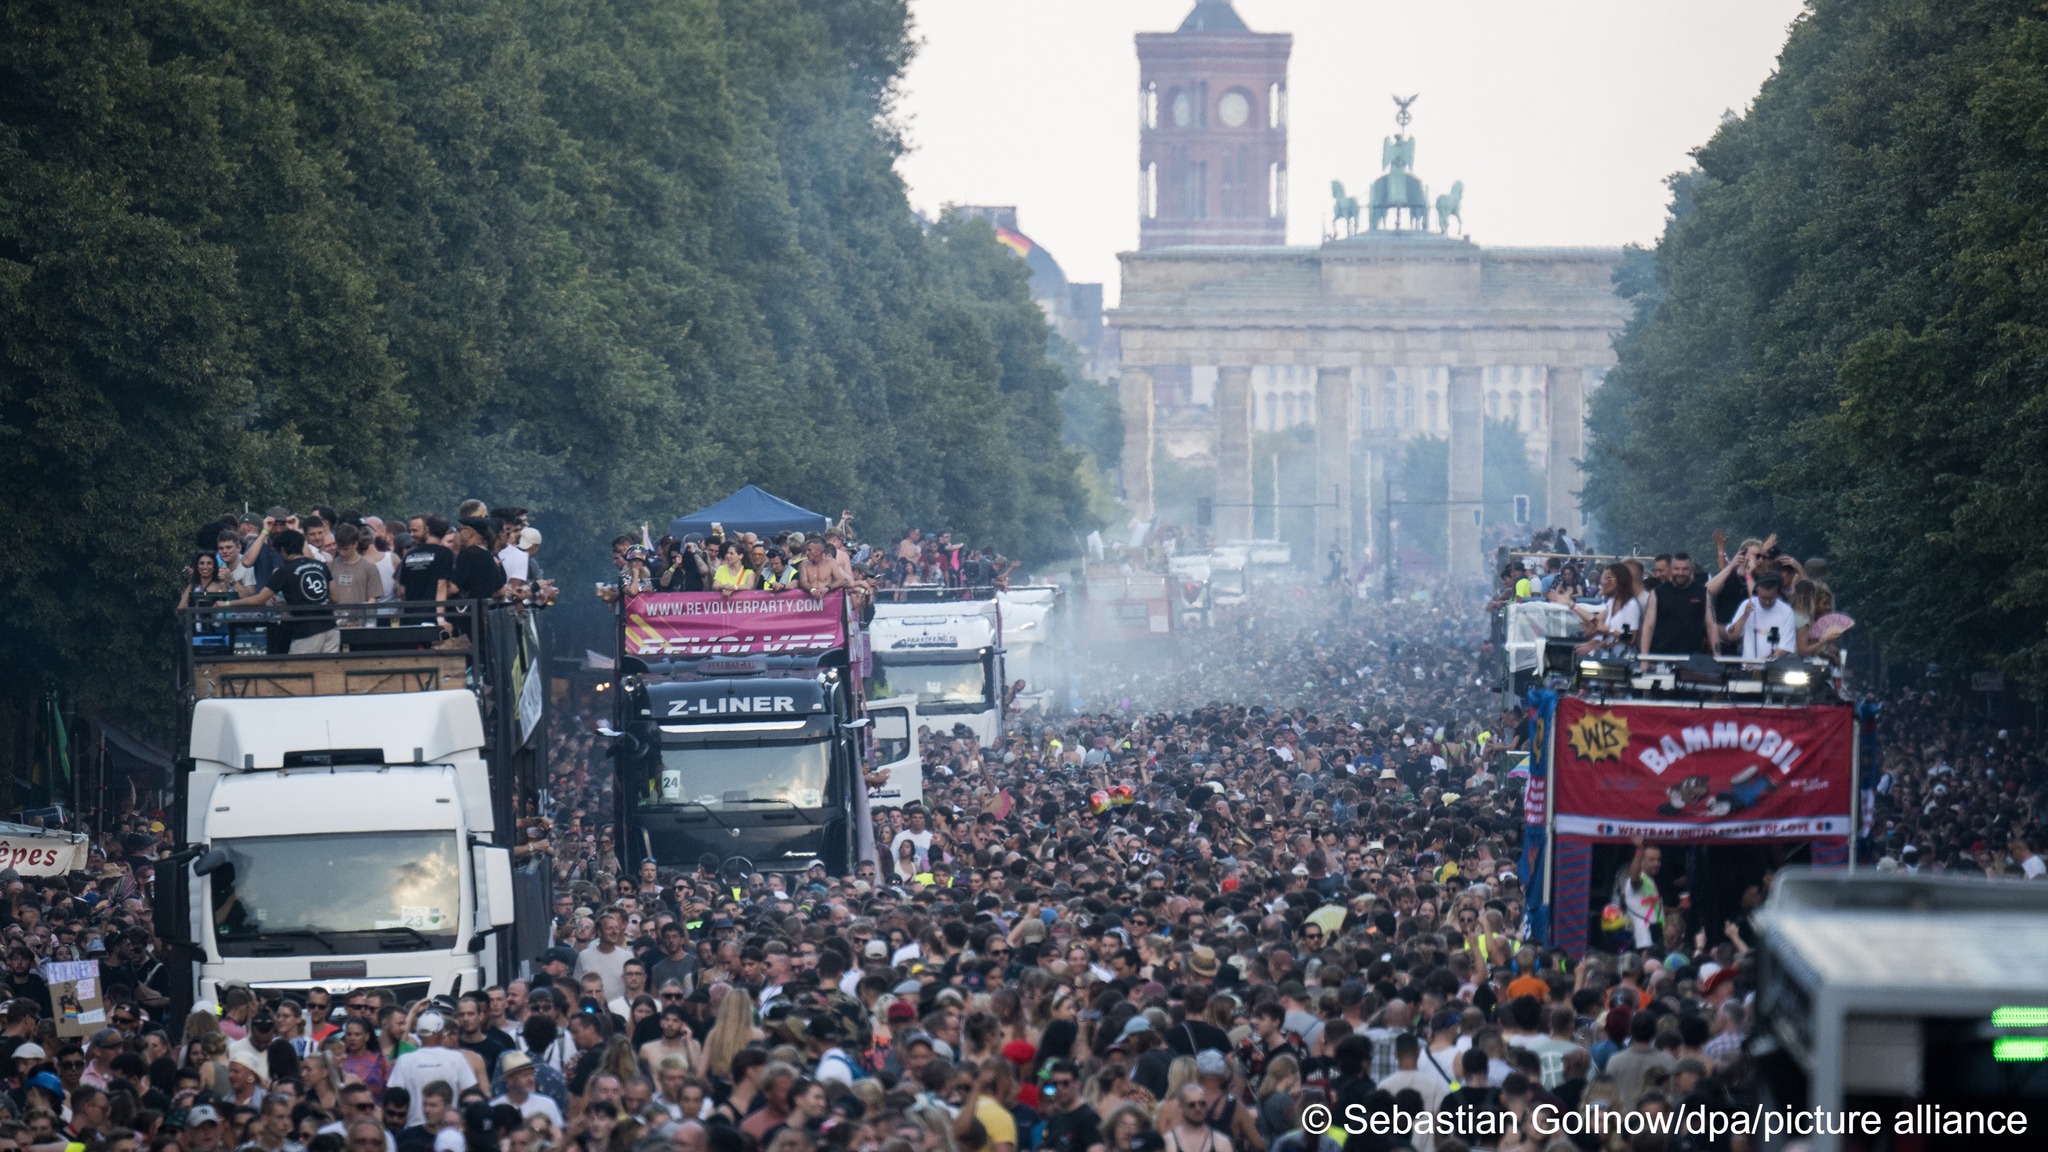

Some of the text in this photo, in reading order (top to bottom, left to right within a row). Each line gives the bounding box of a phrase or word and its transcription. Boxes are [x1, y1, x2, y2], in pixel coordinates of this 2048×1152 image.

[646, 599, 824, 616] WWW.REVOLVERPARTY.COM
[668, 696, 795, 716] Z-LINER
[1581, 720, 1620, 750] WB
[1638, 721, 1803, 776] BAMMOBIL
[663, 777, 679, 788] 24
[405, 915, 423, 928] 23
